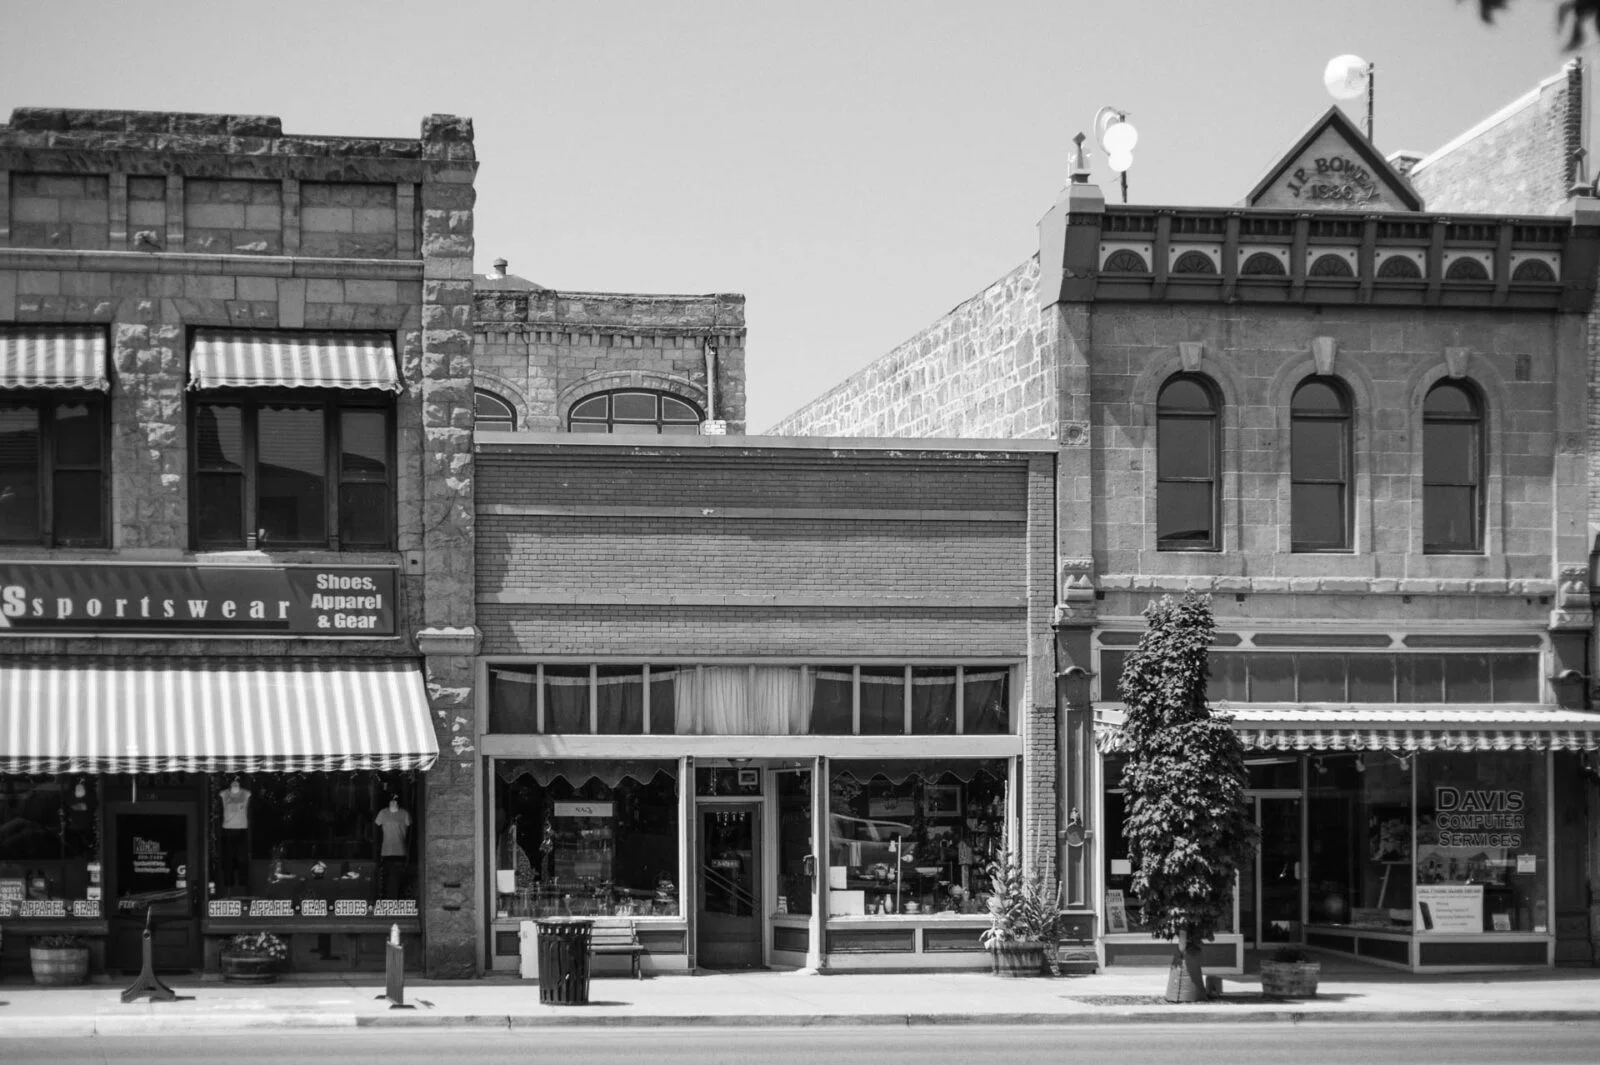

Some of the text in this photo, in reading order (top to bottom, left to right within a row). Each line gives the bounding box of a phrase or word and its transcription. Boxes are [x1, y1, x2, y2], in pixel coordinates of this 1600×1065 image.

[1314, 157, 1380, 200] BOWEN
[316, 573, 377, 592] Shoes,
[311, 593, 382, 611] Apparel
[317, 612, 377, 629] & Gear
[1435, 786, 1524, 812] DAVIS
[1435, 813, 1525, 830] COMPUTER
[1438, 830, 1522, 848] SERVICES
[20, 900, 66, 917] APPAREL
[73, 900, 100, 917] GEAR
[208, 899, 419, 917] SHOES APPAREL GEAR SHOES APPAREL
